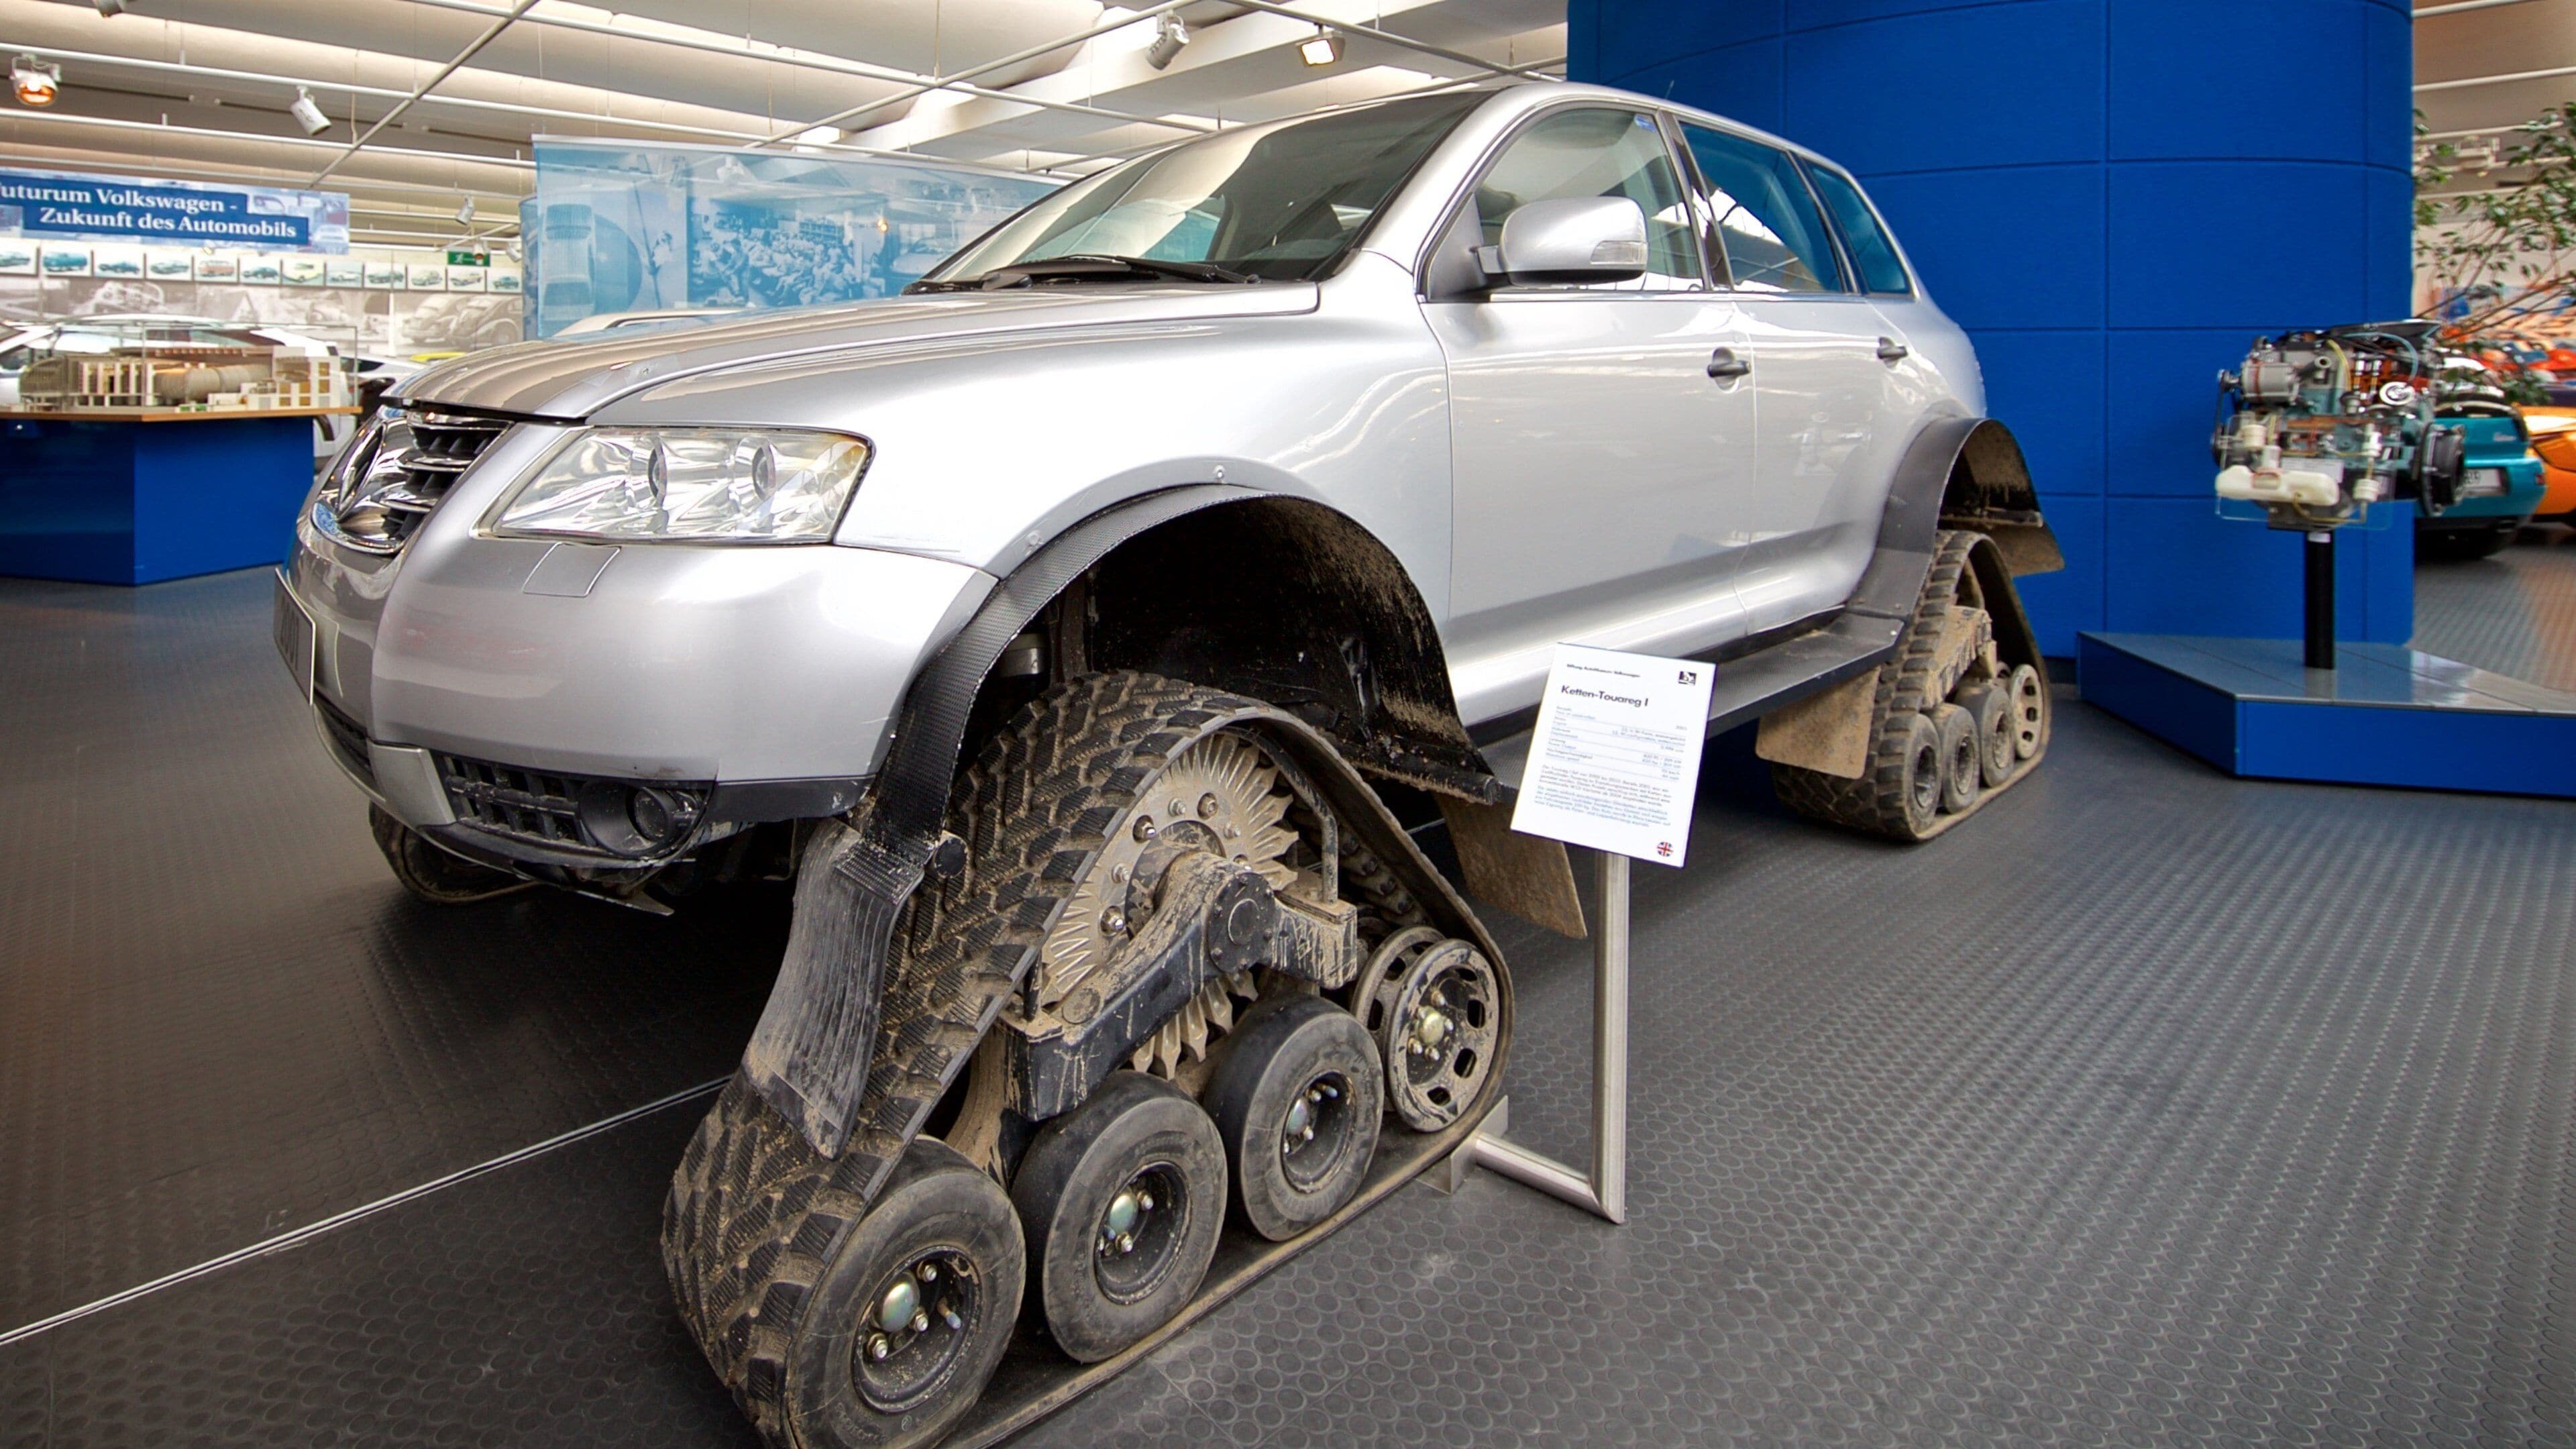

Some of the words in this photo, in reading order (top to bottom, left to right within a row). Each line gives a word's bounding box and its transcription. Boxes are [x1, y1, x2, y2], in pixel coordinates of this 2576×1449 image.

[0, 183, 92, 203] uturum
[96, 188, 225, 214] Volkswagen
[40, 207, 132, 228] Zukunft
[138, 213, 175, 231] des
[178, 216, 297, 237] Automobils
[1561, 685, 1642, 707] Ketten-Touareg
